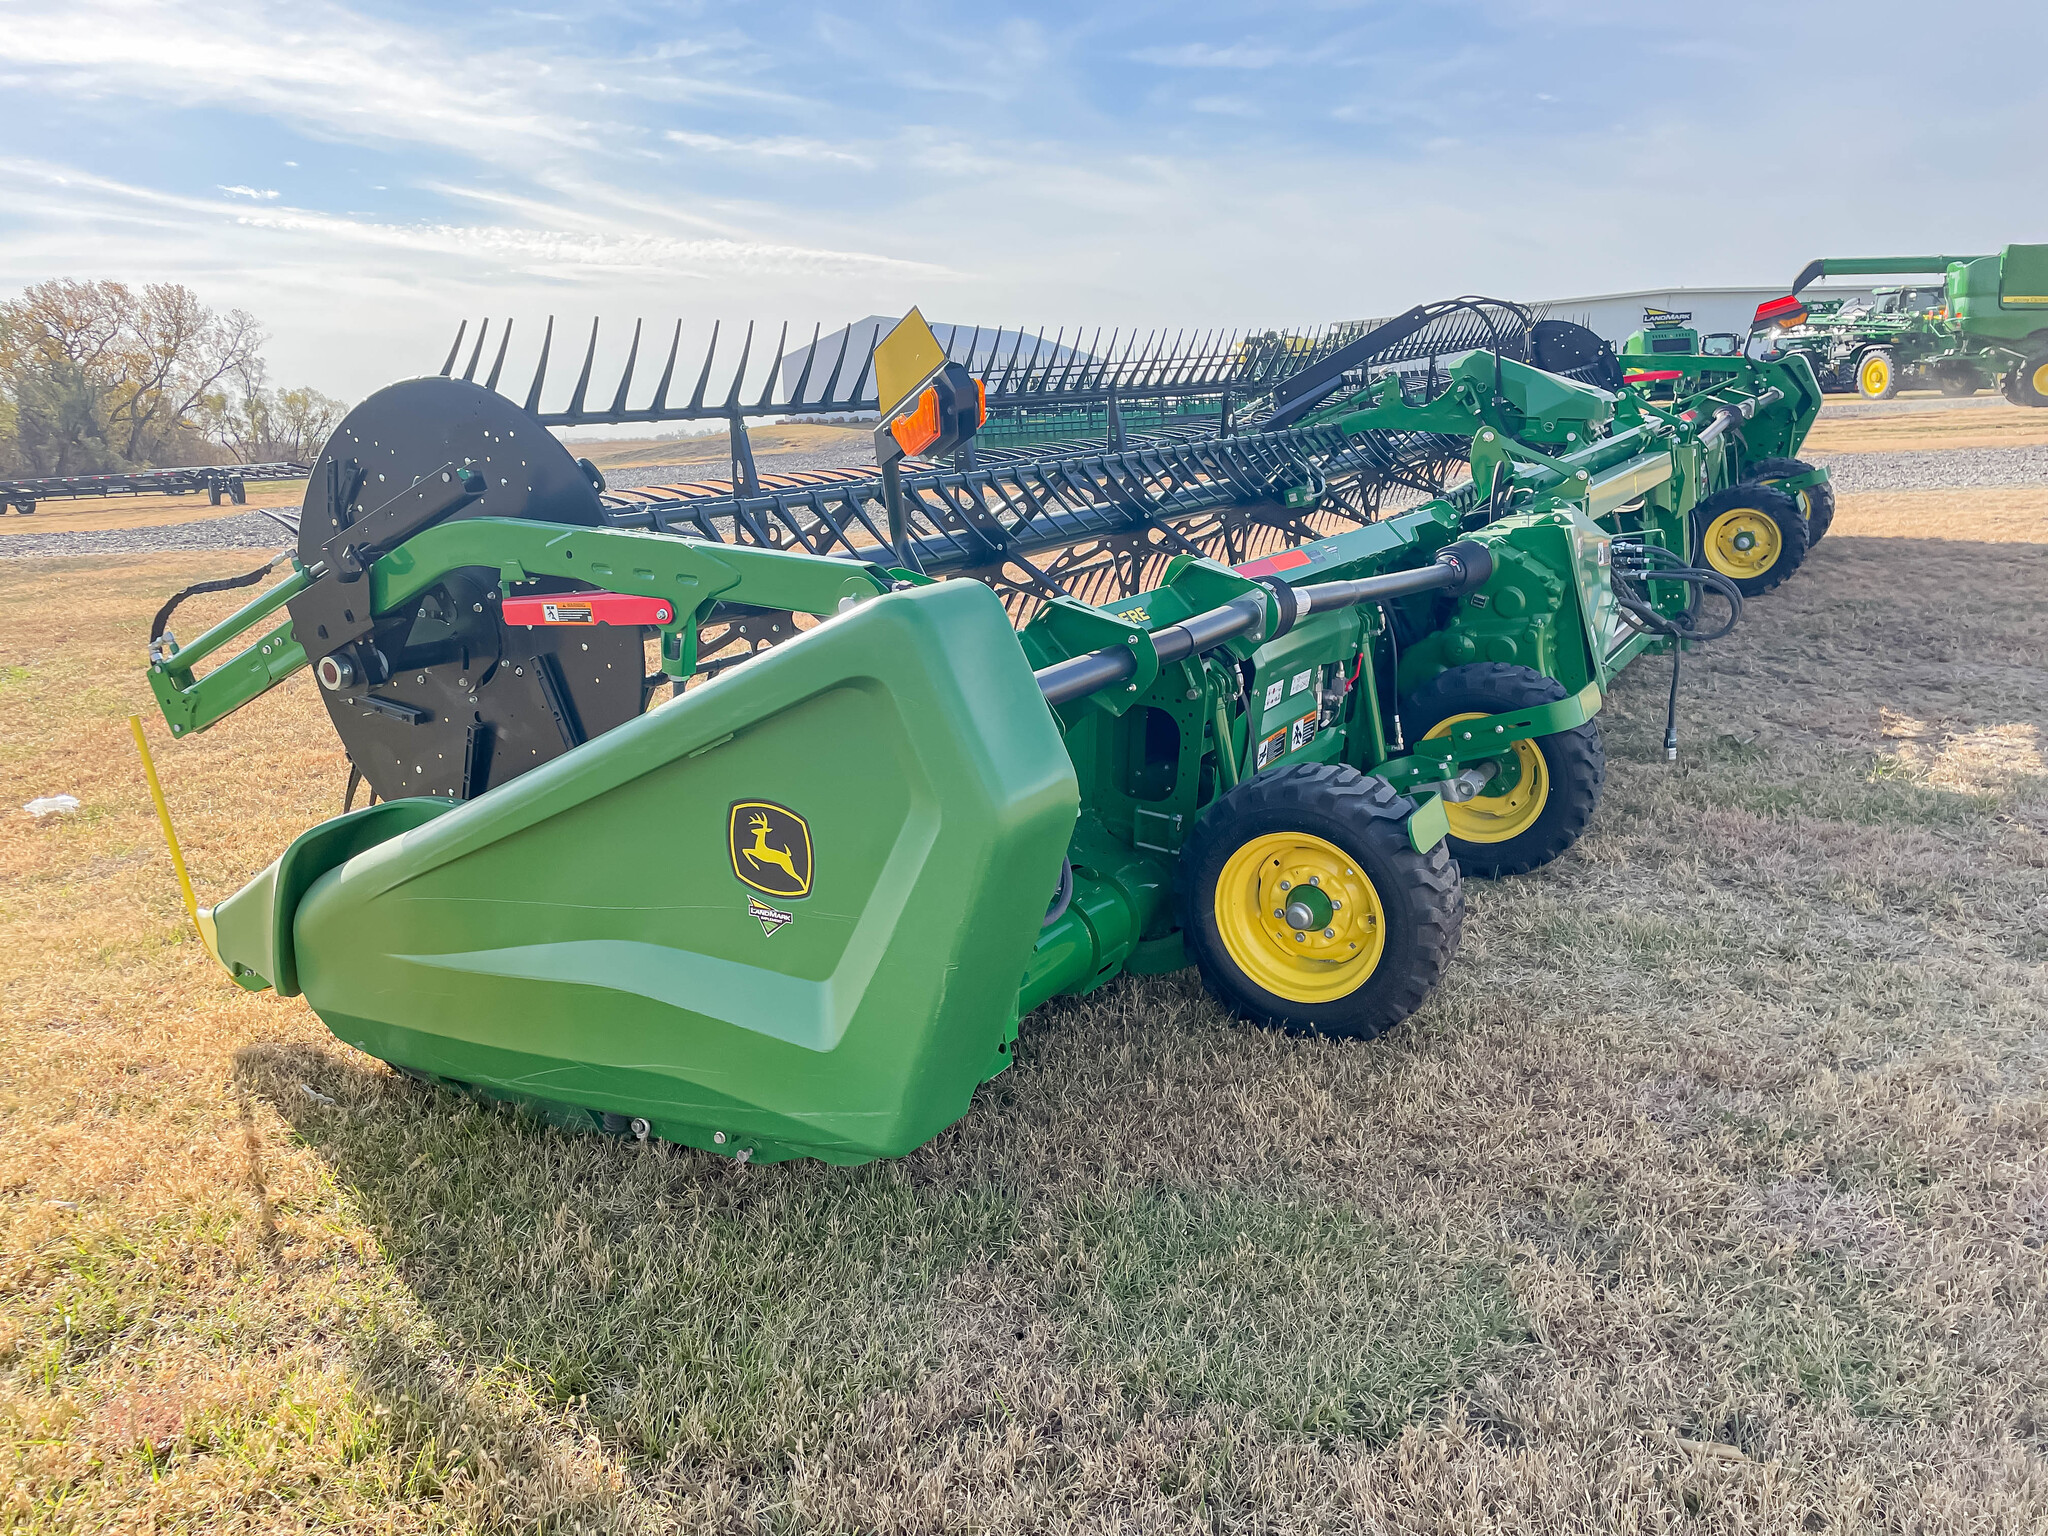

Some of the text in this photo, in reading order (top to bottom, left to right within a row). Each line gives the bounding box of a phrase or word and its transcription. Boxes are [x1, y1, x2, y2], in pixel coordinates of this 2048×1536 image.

[1644, 314, 1690, 322] LANDMARK
[1117, 606, 1151, 624] ERE
[751, 907, 791, 921] LANDMARK
